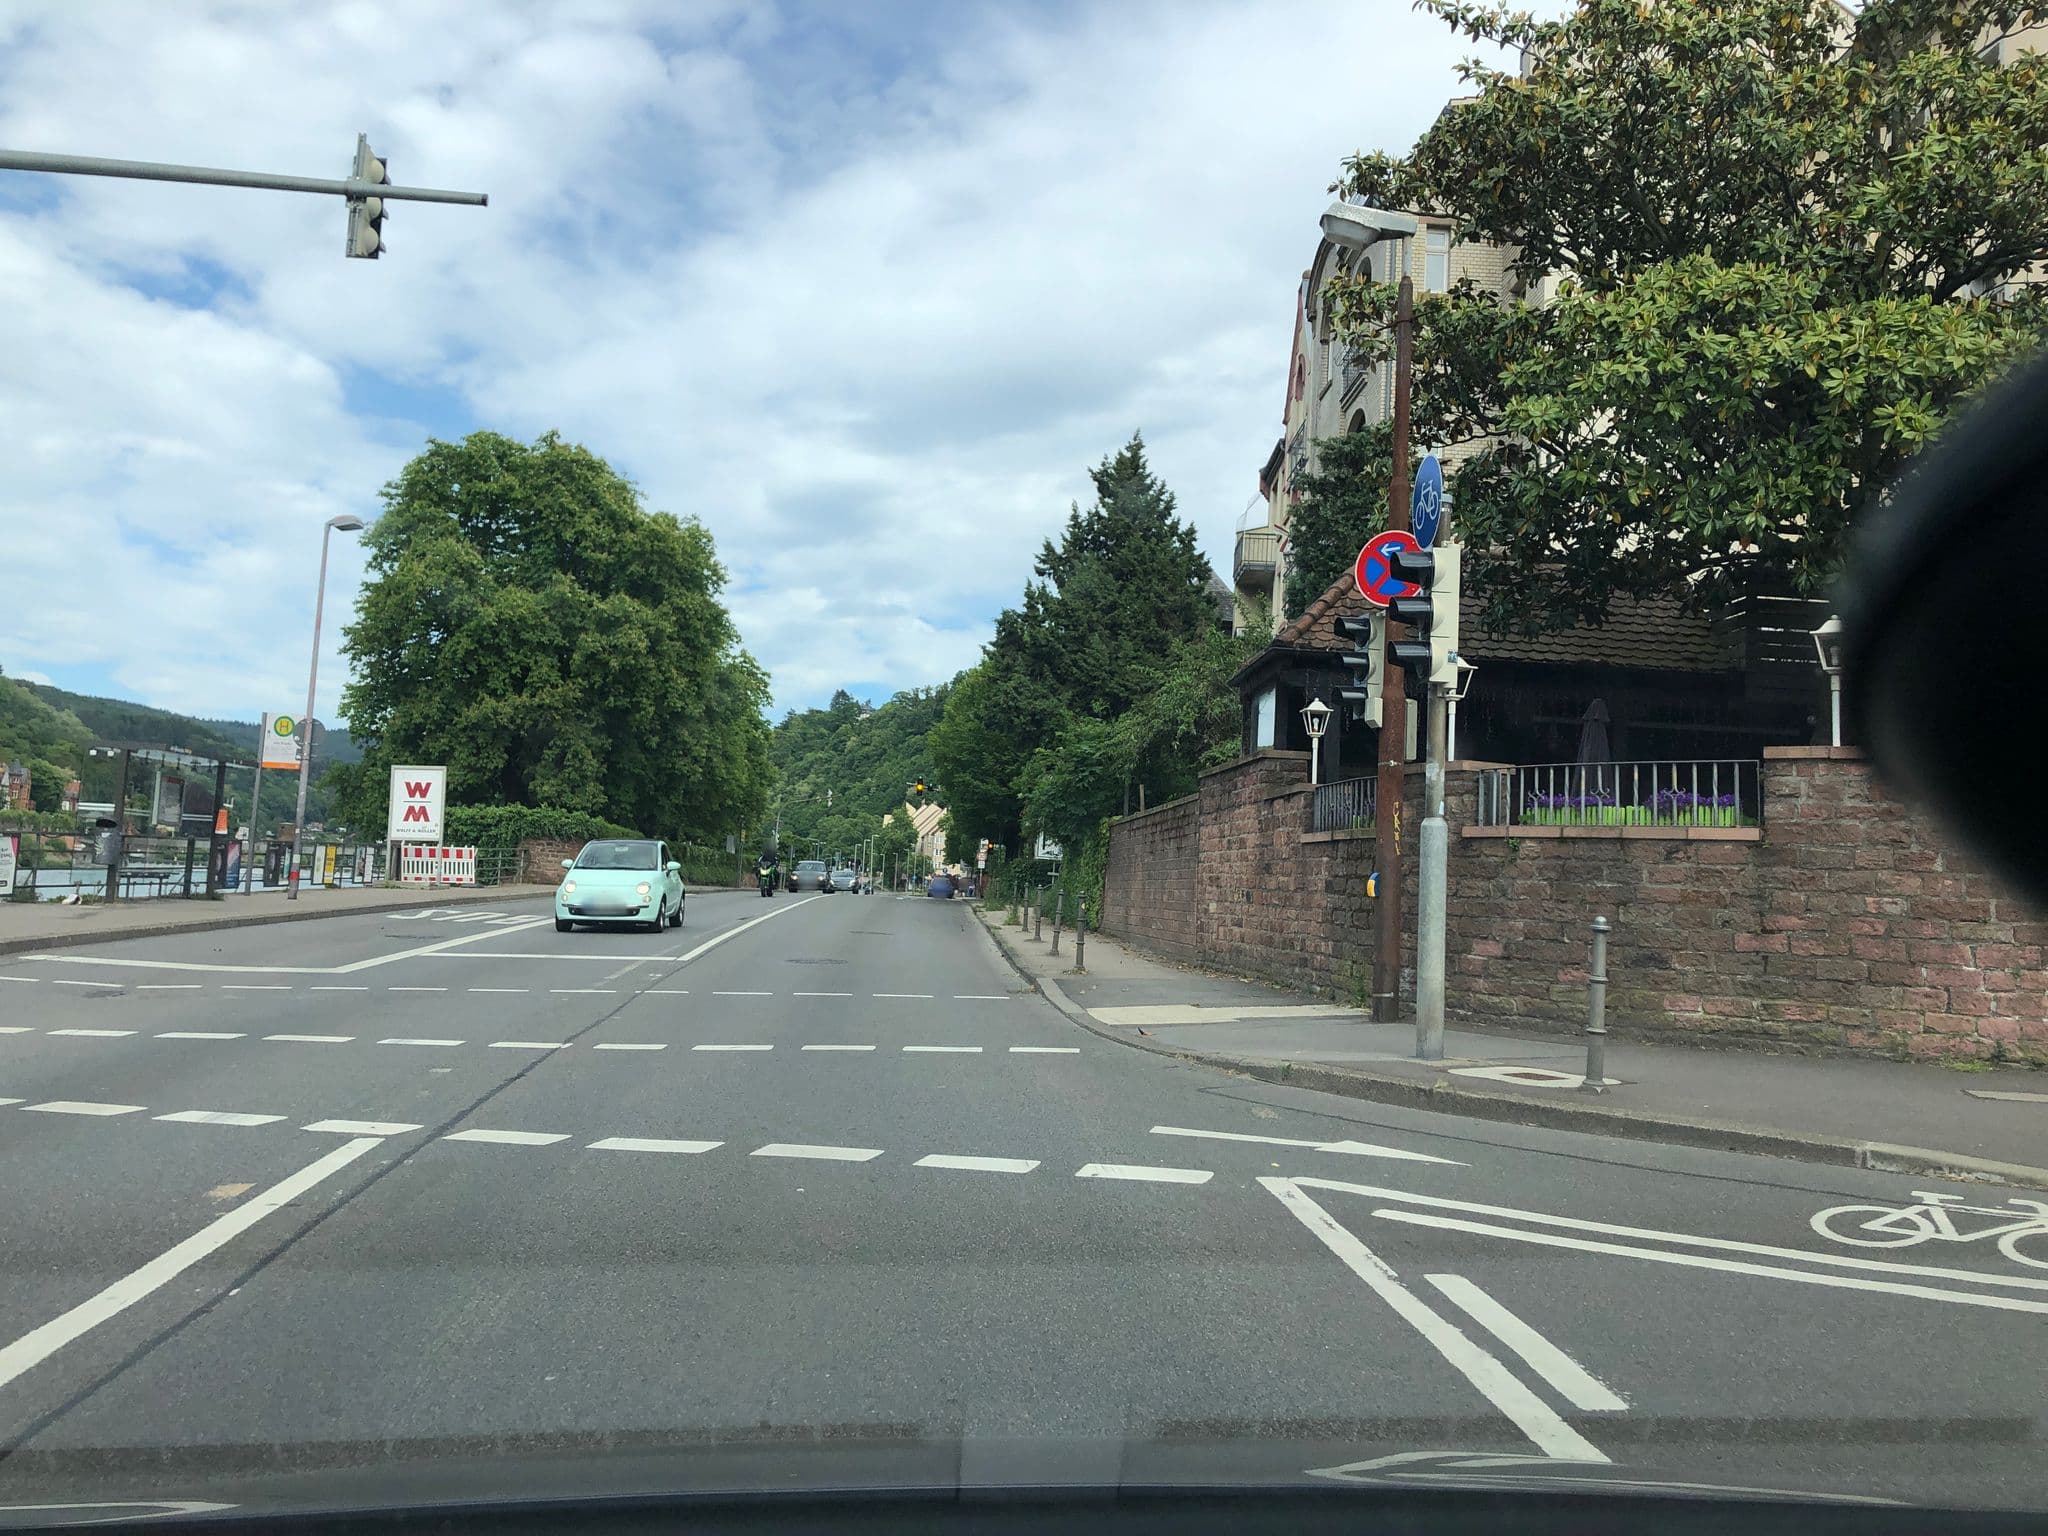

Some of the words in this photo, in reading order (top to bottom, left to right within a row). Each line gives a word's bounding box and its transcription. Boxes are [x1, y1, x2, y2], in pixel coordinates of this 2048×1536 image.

[404, 782, 432, 798] W
[402, 806, 430, 822] M
[386, 909, 549, 924] BUS
